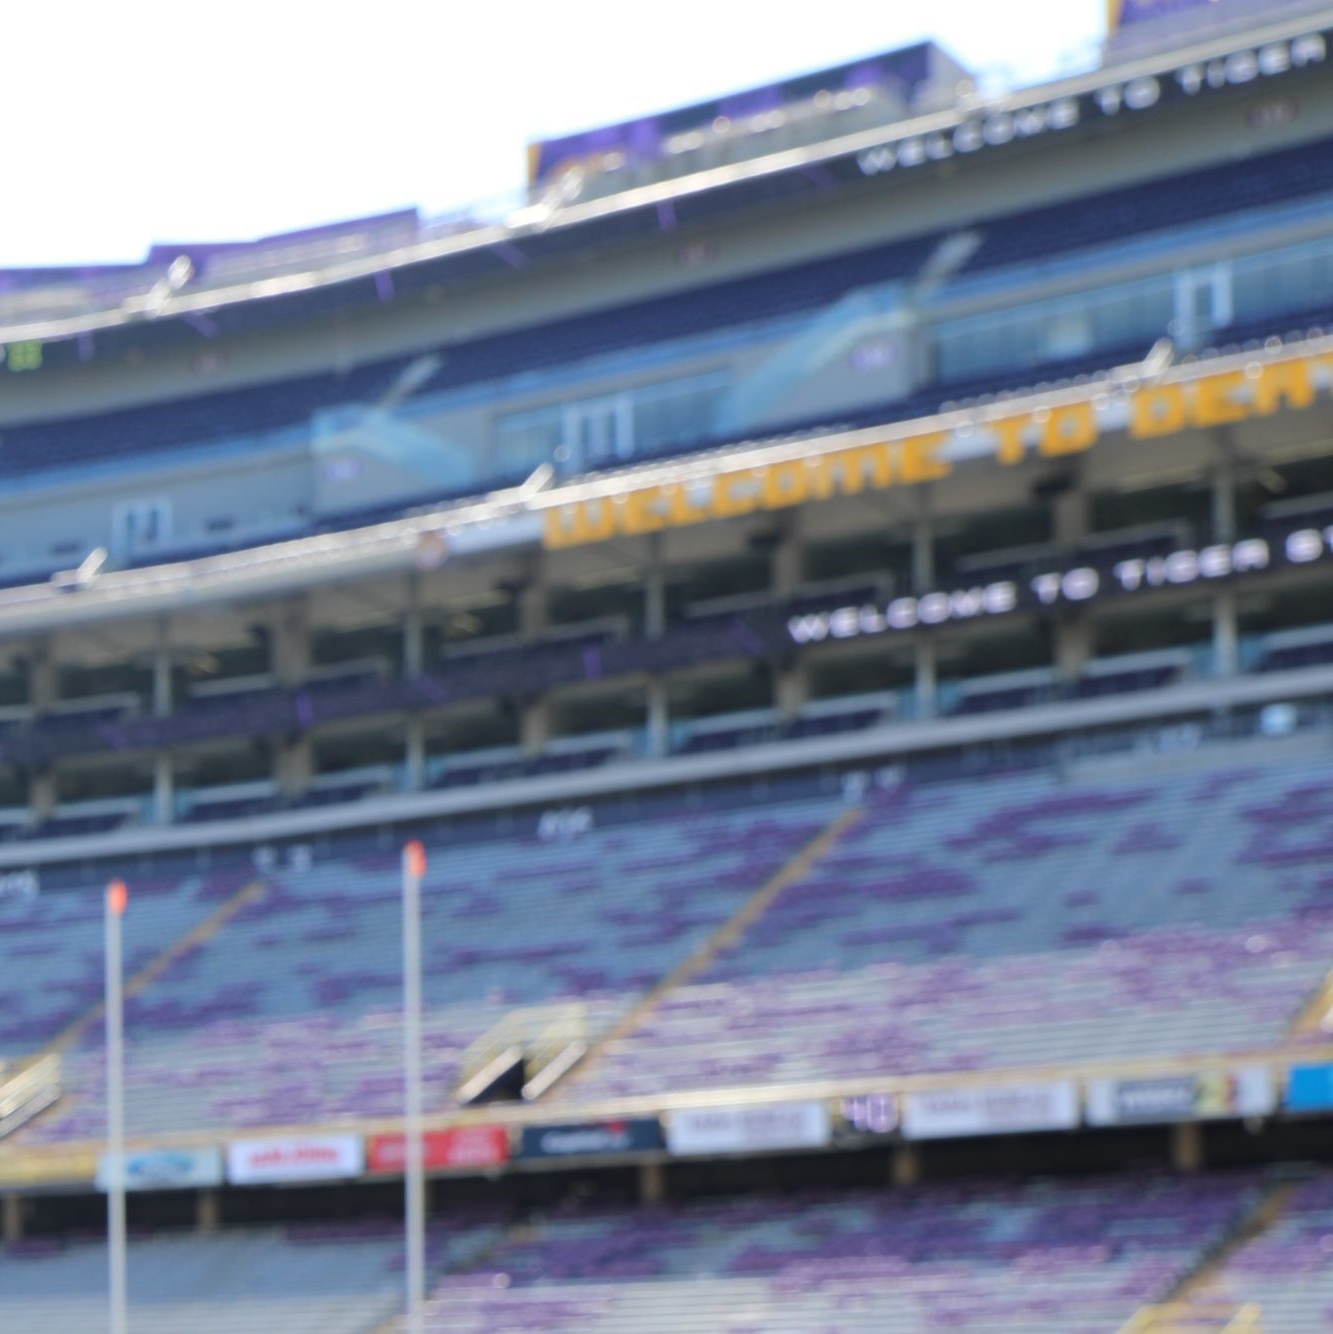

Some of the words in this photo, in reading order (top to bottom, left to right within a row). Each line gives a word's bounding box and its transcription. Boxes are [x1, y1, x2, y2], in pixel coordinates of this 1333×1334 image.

[856, 98, 1080, 176] WELCOME
[1095, 74, 1160, 116] TO
[1174, 31, 1327, 95] TIGER
[543, 430, 954, 549] WELCOME
[993, 400, 1099, 464] TO
[787, 580, 1018, 643] WELCOME
[1030, 567, 1100, 604] TO
[1113, 538, 1270, 591] TIGER
